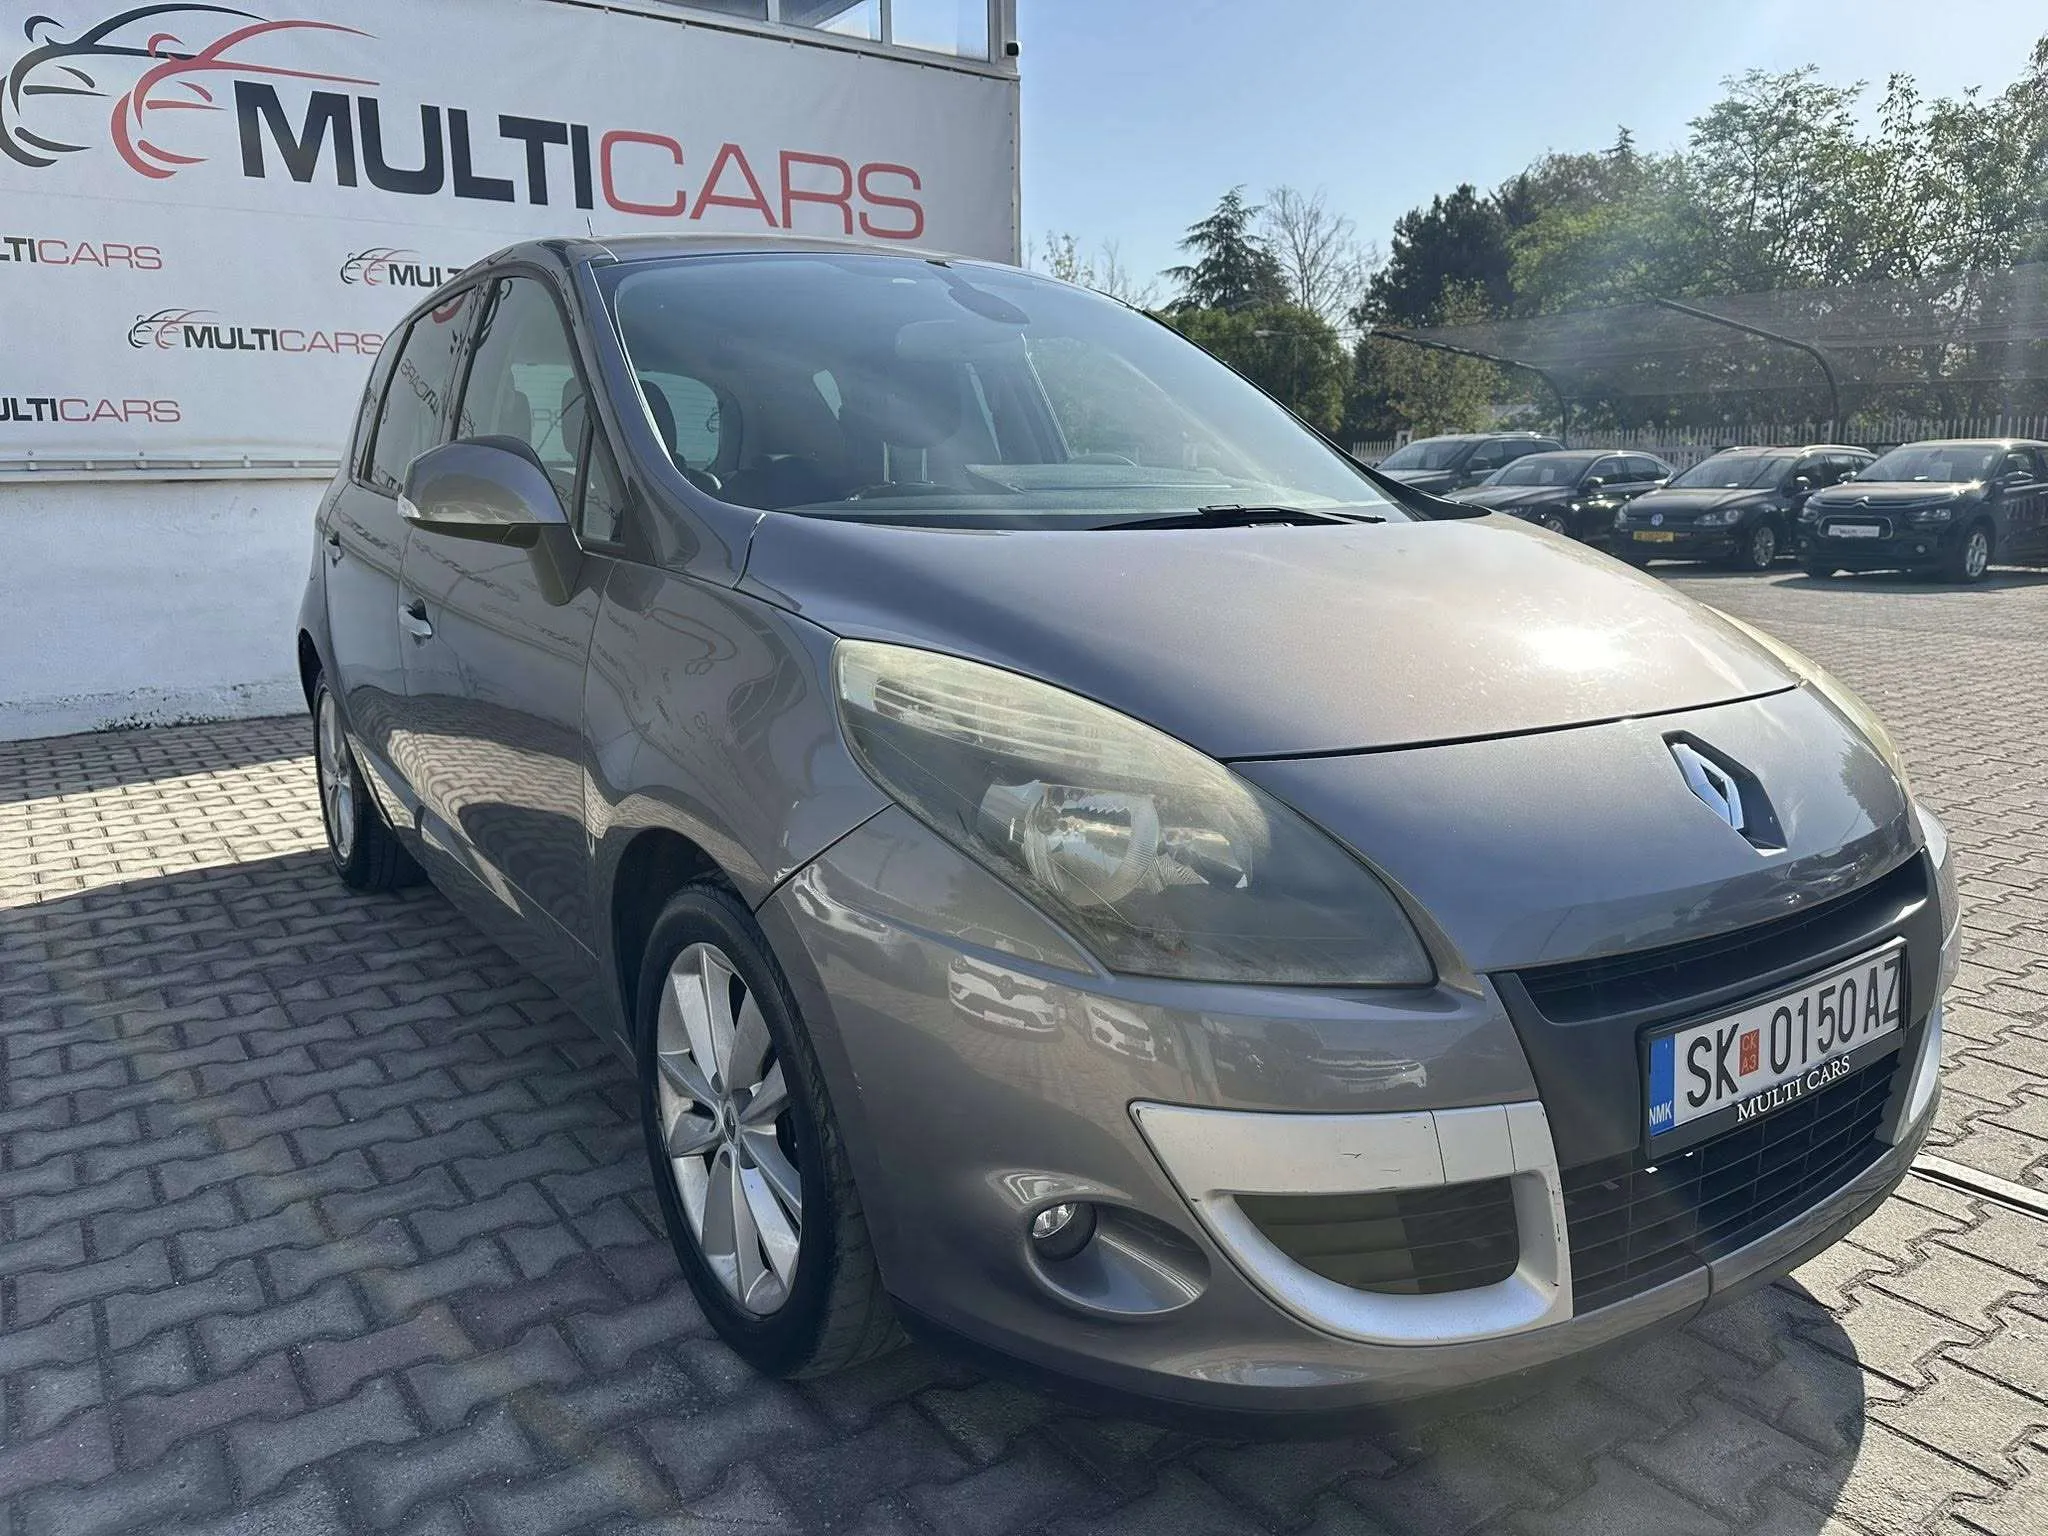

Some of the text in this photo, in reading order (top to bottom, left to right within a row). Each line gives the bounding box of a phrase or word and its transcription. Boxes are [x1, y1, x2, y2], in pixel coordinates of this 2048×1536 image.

[233, 80, 925, 240] MULTICARS
[0, 236, 162, 270] TICARS
[183, 325, 384, 355] MULTICARS
[1687, 1023, 1739, 1108] SK
[1737, 1055, 1850, 1122] MULTI CARS
[1649, 1100, 1673, 1127] NMK
